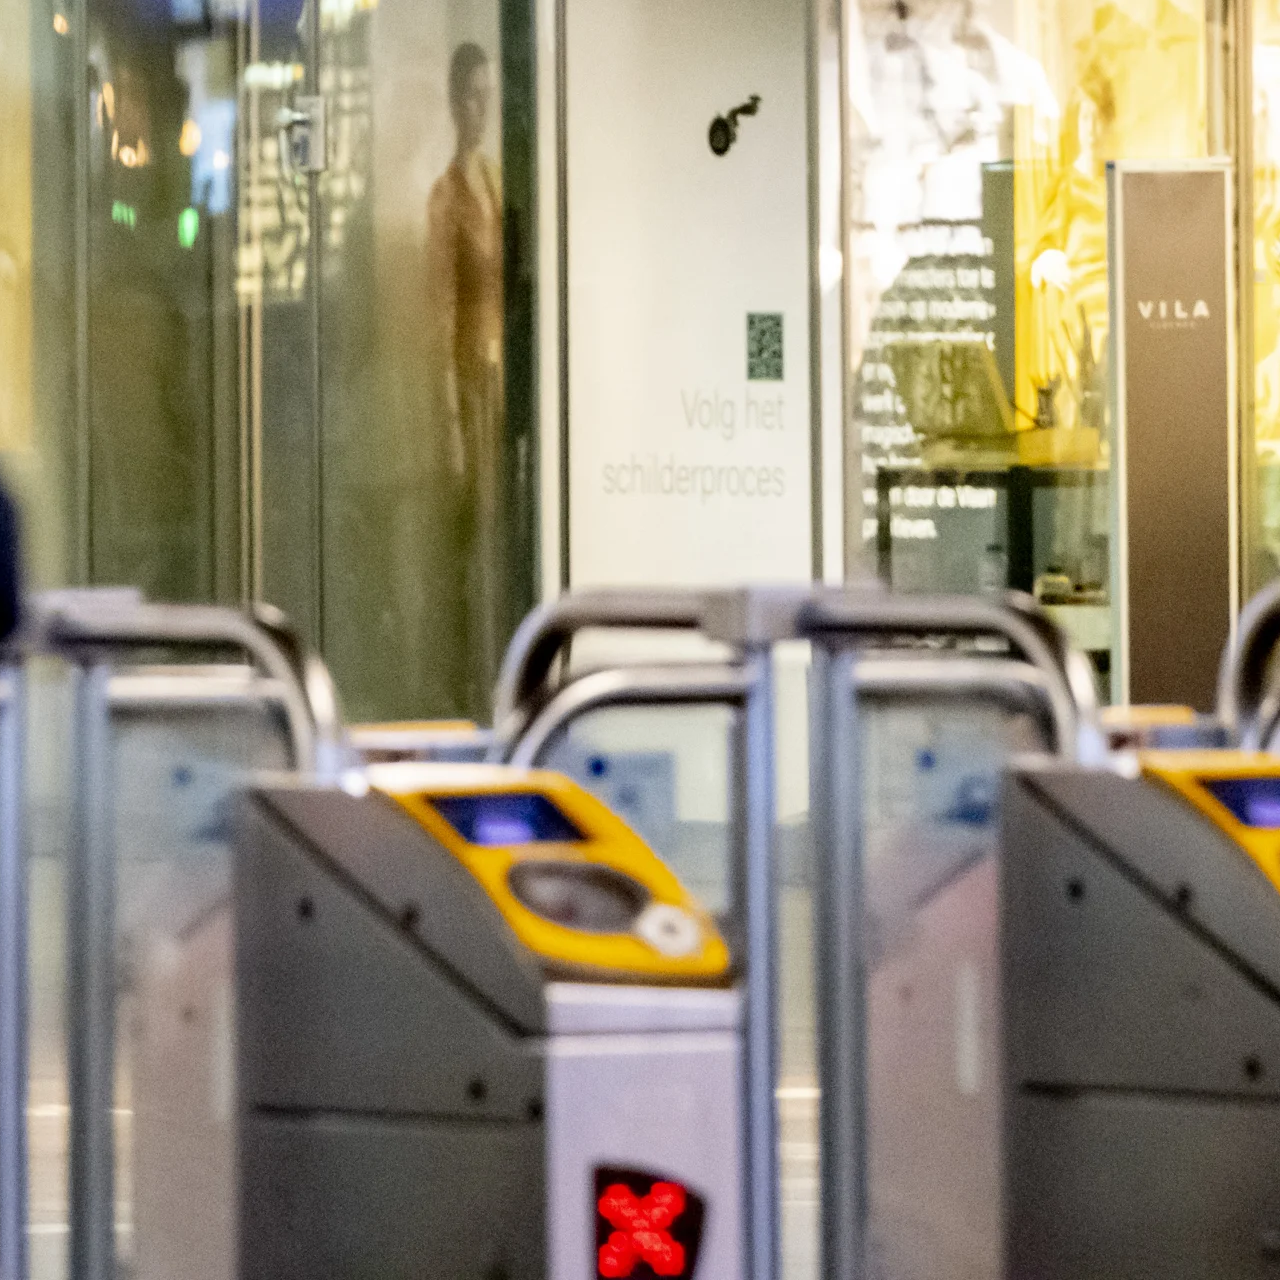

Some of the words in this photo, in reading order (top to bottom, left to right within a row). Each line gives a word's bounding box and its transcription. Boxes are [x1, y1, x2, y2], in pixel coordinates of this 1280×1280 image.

[1137, 299, 1210, 319] VILA
[680, 387, 737, 441] Volg
[744, 387, 786, 431] het
[602, 452, 787, 505] schilderproces
